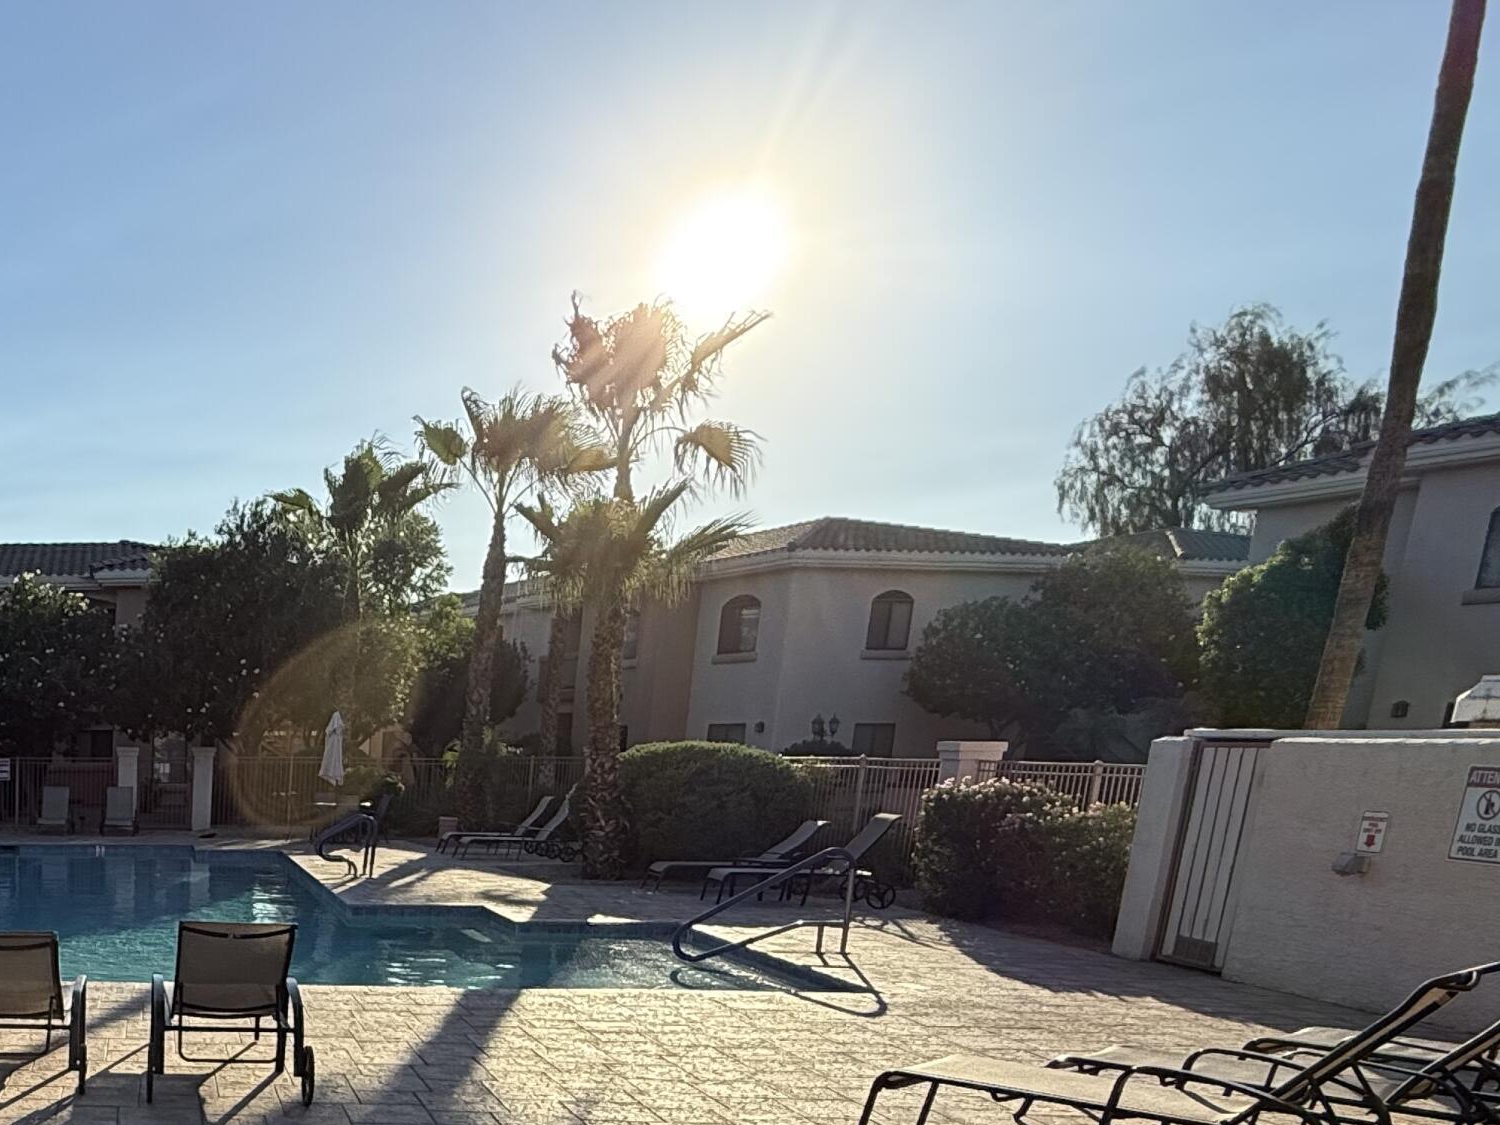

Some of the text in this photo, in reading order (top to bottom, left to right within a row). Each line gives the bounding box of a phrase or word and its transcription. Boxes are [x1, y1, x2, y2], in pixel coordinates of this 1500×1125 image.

[1465, 822, 1477, 832] NO
[1457, 834, 1494, 846] ALLOWED
[1457, 846, 1498, 858] POOL AREA
